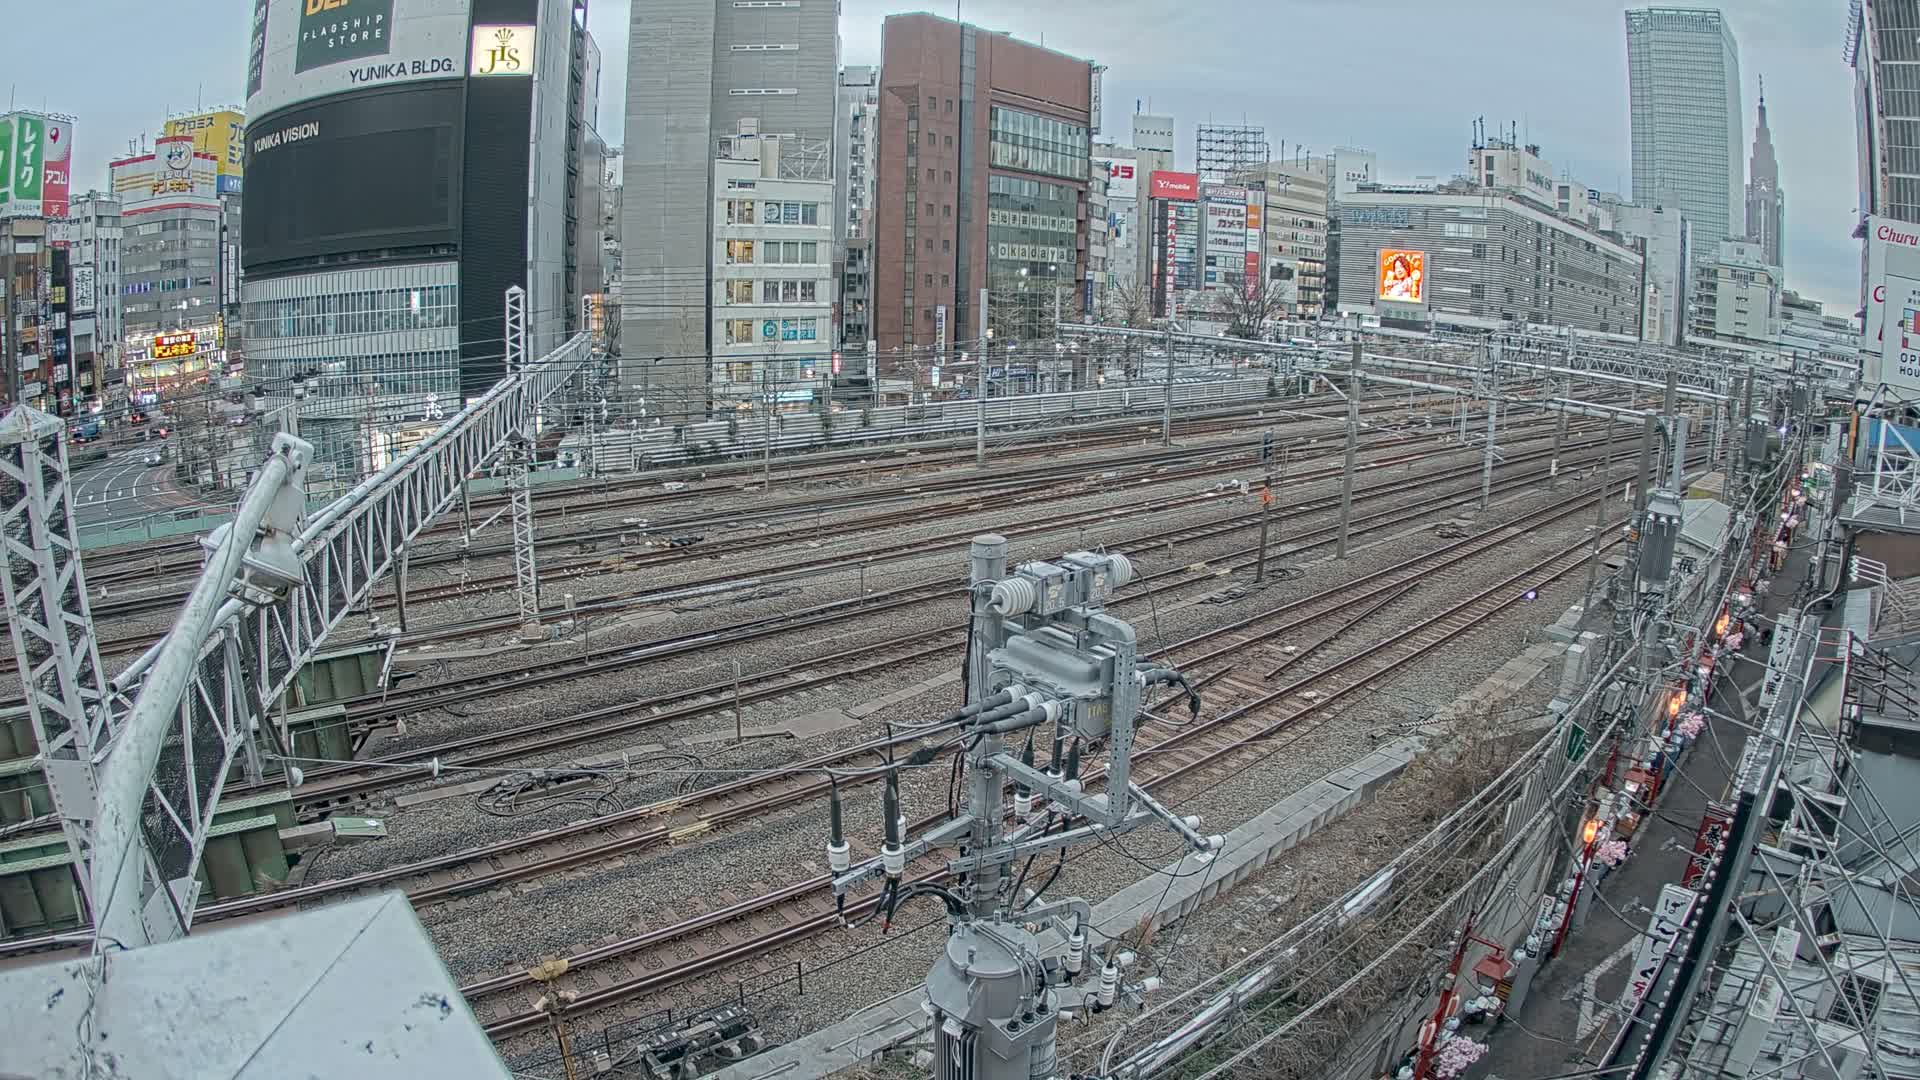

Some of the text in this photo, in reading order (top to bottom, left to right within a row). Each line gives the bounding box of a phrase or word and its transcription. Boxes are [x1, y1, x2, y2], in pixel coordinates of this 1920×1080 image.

[303, 14, 384, 41] FLAGSHIP
[328, 28, 382, 48] STORE
[350, 58, 456, 83] YUNIKA BLDG.
[254, 121, 320, 153] YUNIKA VISION
[20, 121, 37, 188] レイク
[45, 170, 68, 185] アコム
